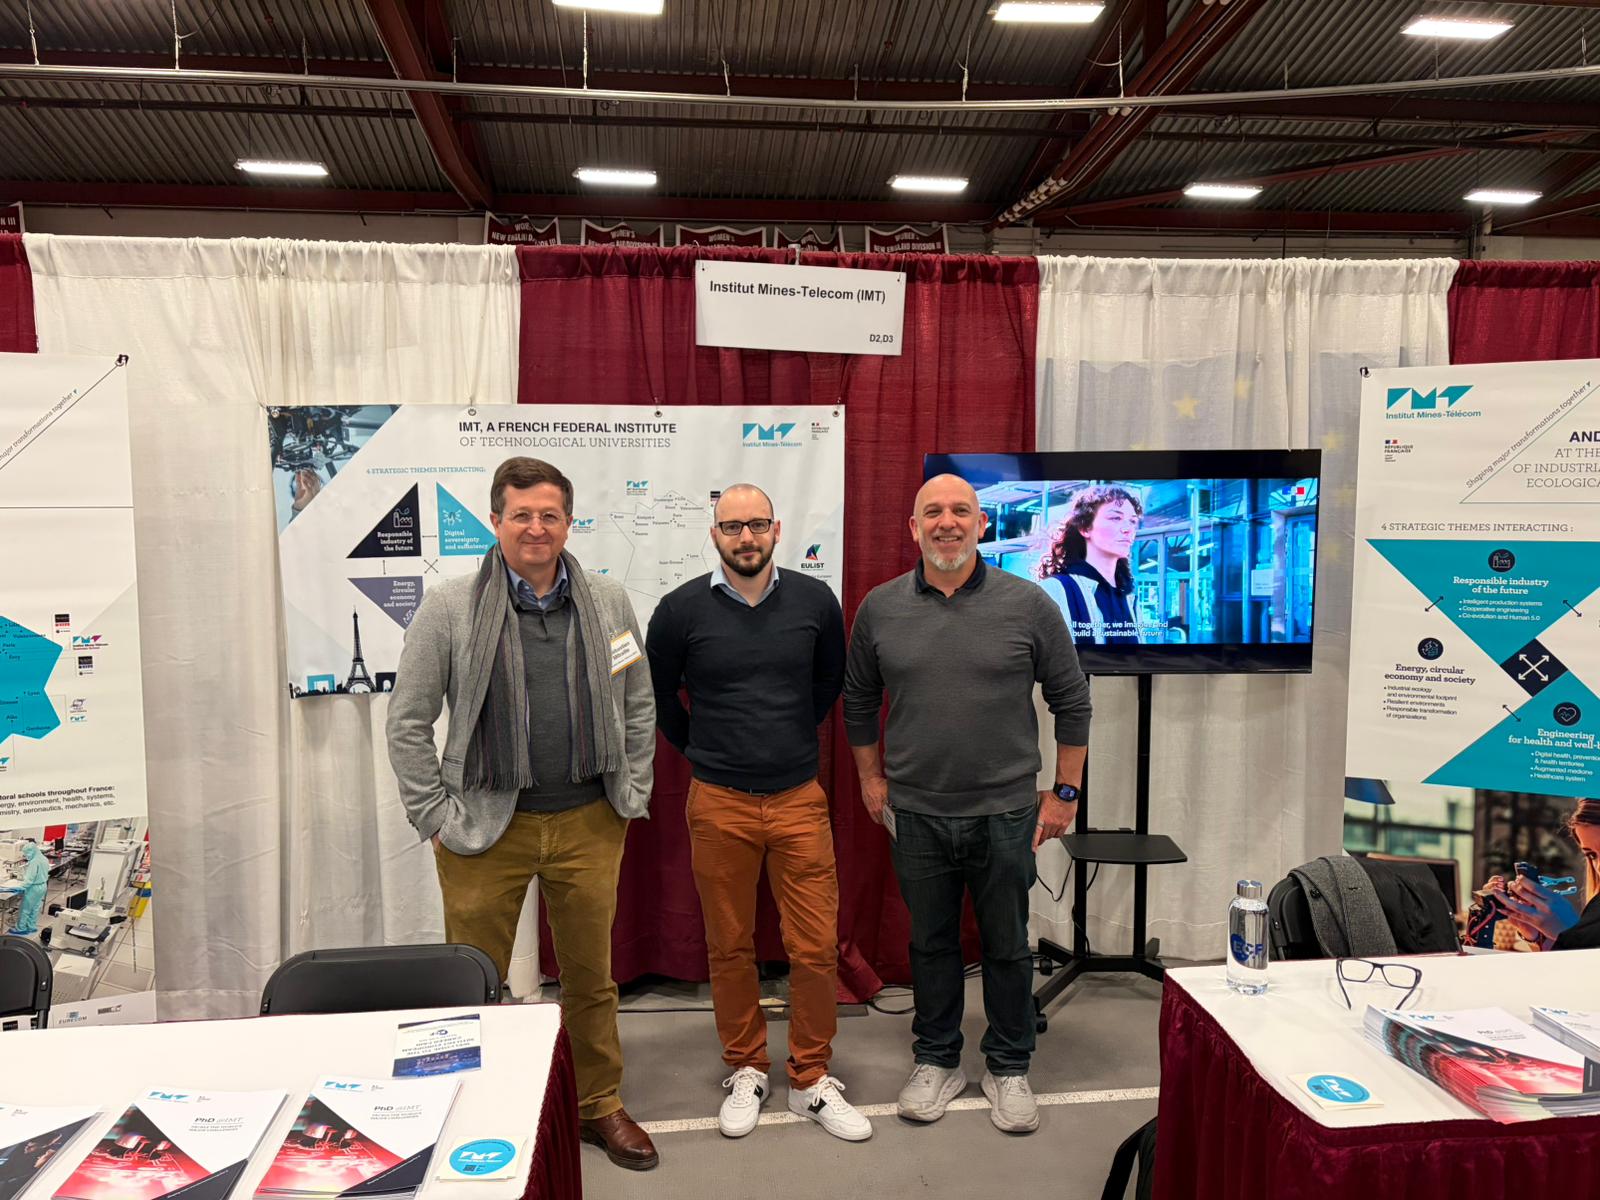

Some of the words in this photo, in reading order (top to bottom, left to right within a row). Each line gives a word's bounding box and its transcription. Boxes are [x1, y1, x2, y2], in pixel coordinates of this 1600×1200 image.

[710, 280, 755, 295] Institut
[758, 283, 854, 300] Mines-Telecom
[857, 289, 886, 304] (IMT)
[869, 334, 894, 344] D2,D3
[12, 410, 53, 448] transformations
[52, 392, 73, 413] together
[459, 421, 483, 433] IMT,
[486, 422, 495, 432] A
[498, 422, 550, 433] FRENCH
[553, 422, 611, 433] FEDERAL
[614, 423, 677, 433] INSTITUTE
[459, 437, 477, 447] OF
[480, 437, 586, 448] TECHNOLOGICAL
[589, 437, 671, 448] UNIVERSITIES
[1465, 465, 1494, 489] Shaping
[1492, 449, 1511, 468] major
[1511, 408, 1561, 452] transformations
[1560, 385, 1587, 410] together
[1554, 448, 1573, 458] AT
[1512, 463, 1532, 474] OF
[444, 529, 465, 537] Digital
[1388, 523, 1446, 531] STRATEGIC
[1447, 523, 1491, 532] THEMES
[1493, 523, 1568, 533] INTERACTING
[377, 531, 413, 539] Responsible
[444, 536, 480, 544] sovereignty
[392, 581, 416, 589] Energy,
[1453, 576, 1508, 586] Responsible
[1509, 577, 1549, 588] industry
[1471, 585, 1482, 593] of
[1483, 585, 1498, 594] the
[1499, 586, 1529, 594] future
[1072, 629, 1091, 637] build
[1395, 663, 1428, 674] Energy,
[1429, 665, 1465, 675] circular
[1384, 674, 1424, 682] economy
[1425, 674, 1442, 682] and
[1443, 675, 1476, 685] society
[1419, 707, 1457, 715] transformation
[1537, 728, 1596, 741] Engineering
[1508, 734, 1522, 744] for
[1523, 736, 1553, 747] health
[1554, 739, 1573, 748] and
[1534, 750, 1553, 758] Digital
[17, 790, 46, 799] schools
[47, 787, 87, 797] throughout
[88, 785, 115, 793] France:
[18, 797, 60, 807] environment,
[62, 795, 85, 803] health,
[86, 793, 115, 801] systems,
[22, 804, 63, 814] aeronautics,
[65, 802, 102, 810] mechanics,
